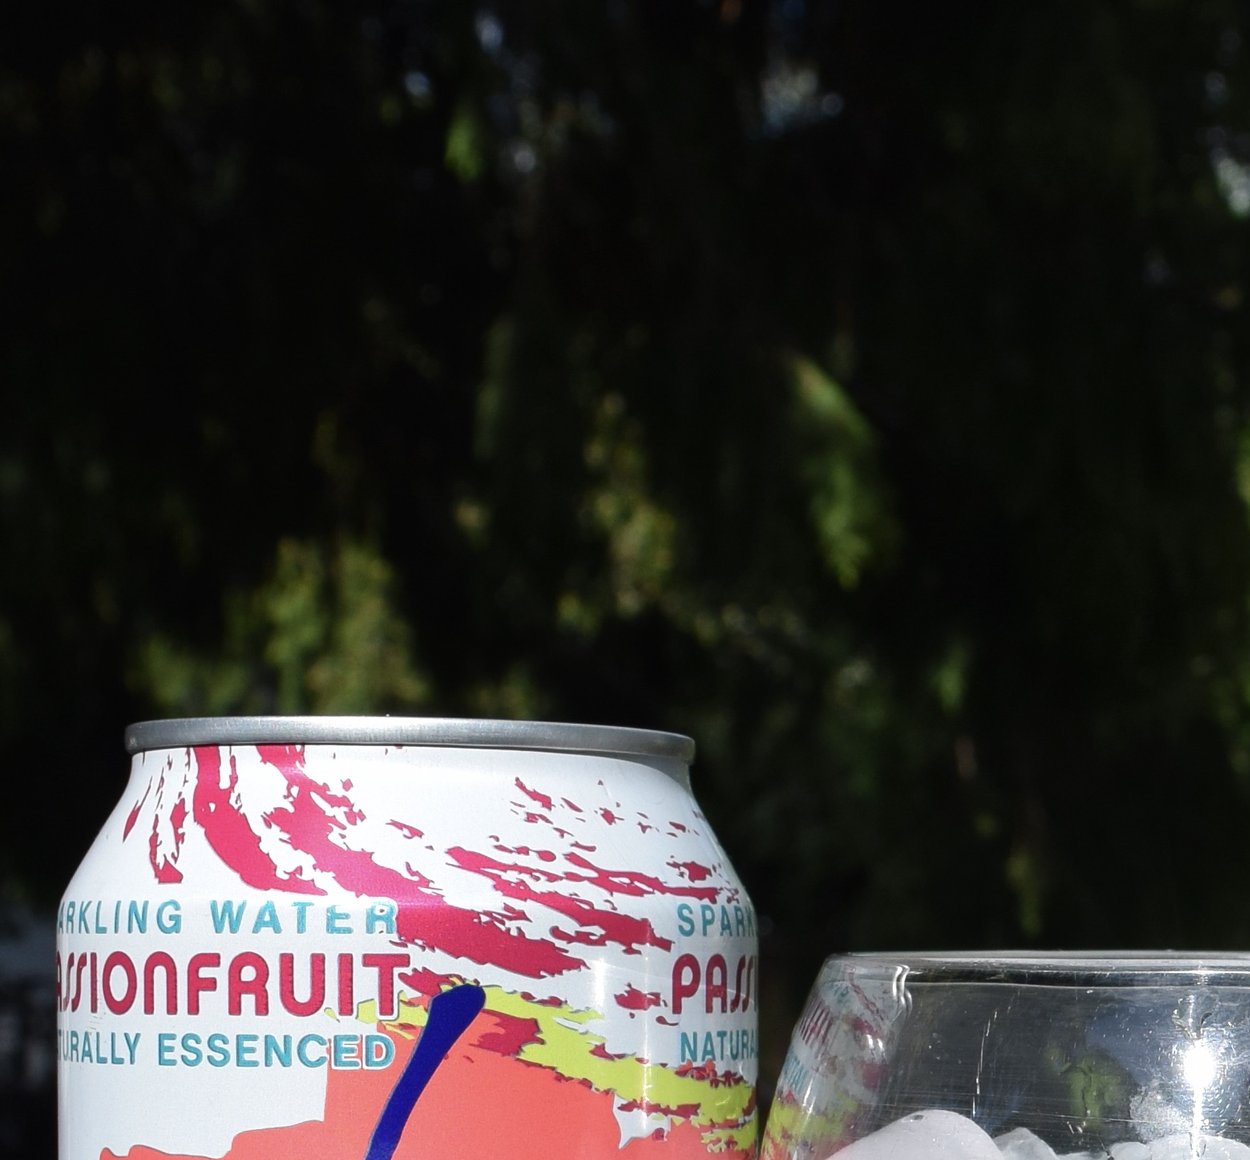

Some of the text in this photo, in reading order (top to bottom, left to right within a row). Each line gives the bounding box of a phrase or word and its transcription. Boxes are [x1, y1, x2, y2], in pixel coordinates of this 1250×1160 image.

[57, 899, 396, 935] ARKLING WATER
[56, 950, 411, 1018] ASSIONFRUIT
[57, 1029, 395, 1069] TURALLY ESSENCED
